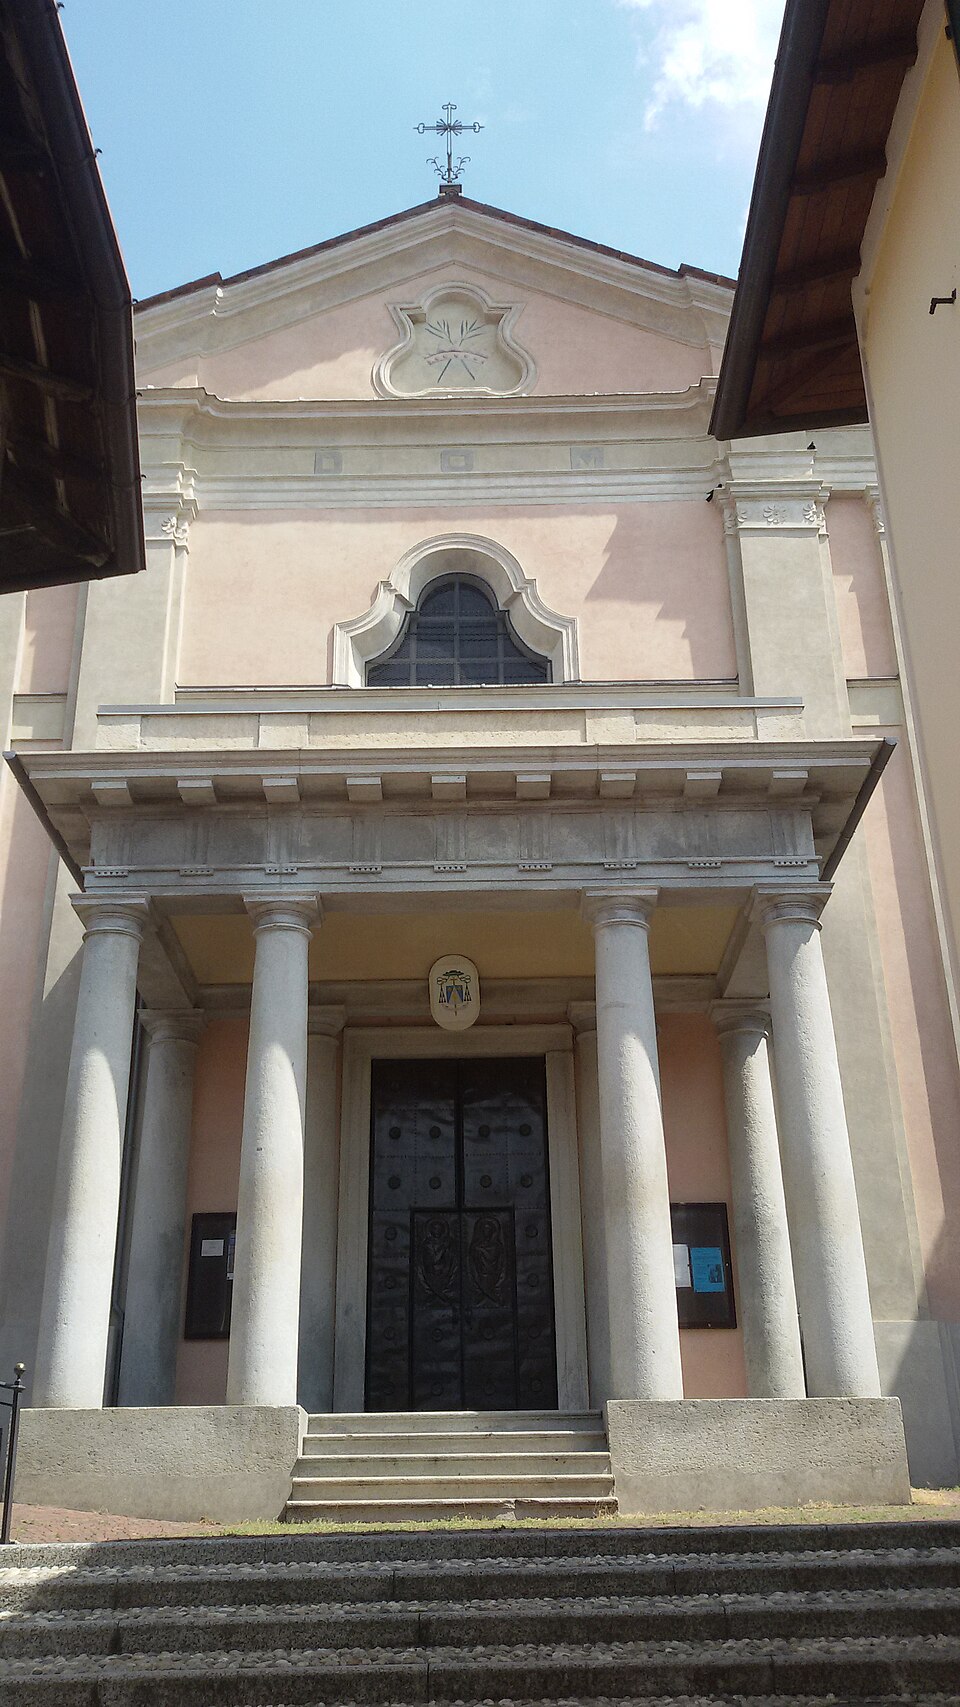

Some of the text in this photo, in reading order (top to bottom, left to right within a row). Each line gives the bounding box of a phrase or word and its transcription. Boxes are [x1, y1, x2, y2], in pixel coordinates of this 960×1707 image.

[314, 447, 604, 474] D O M
